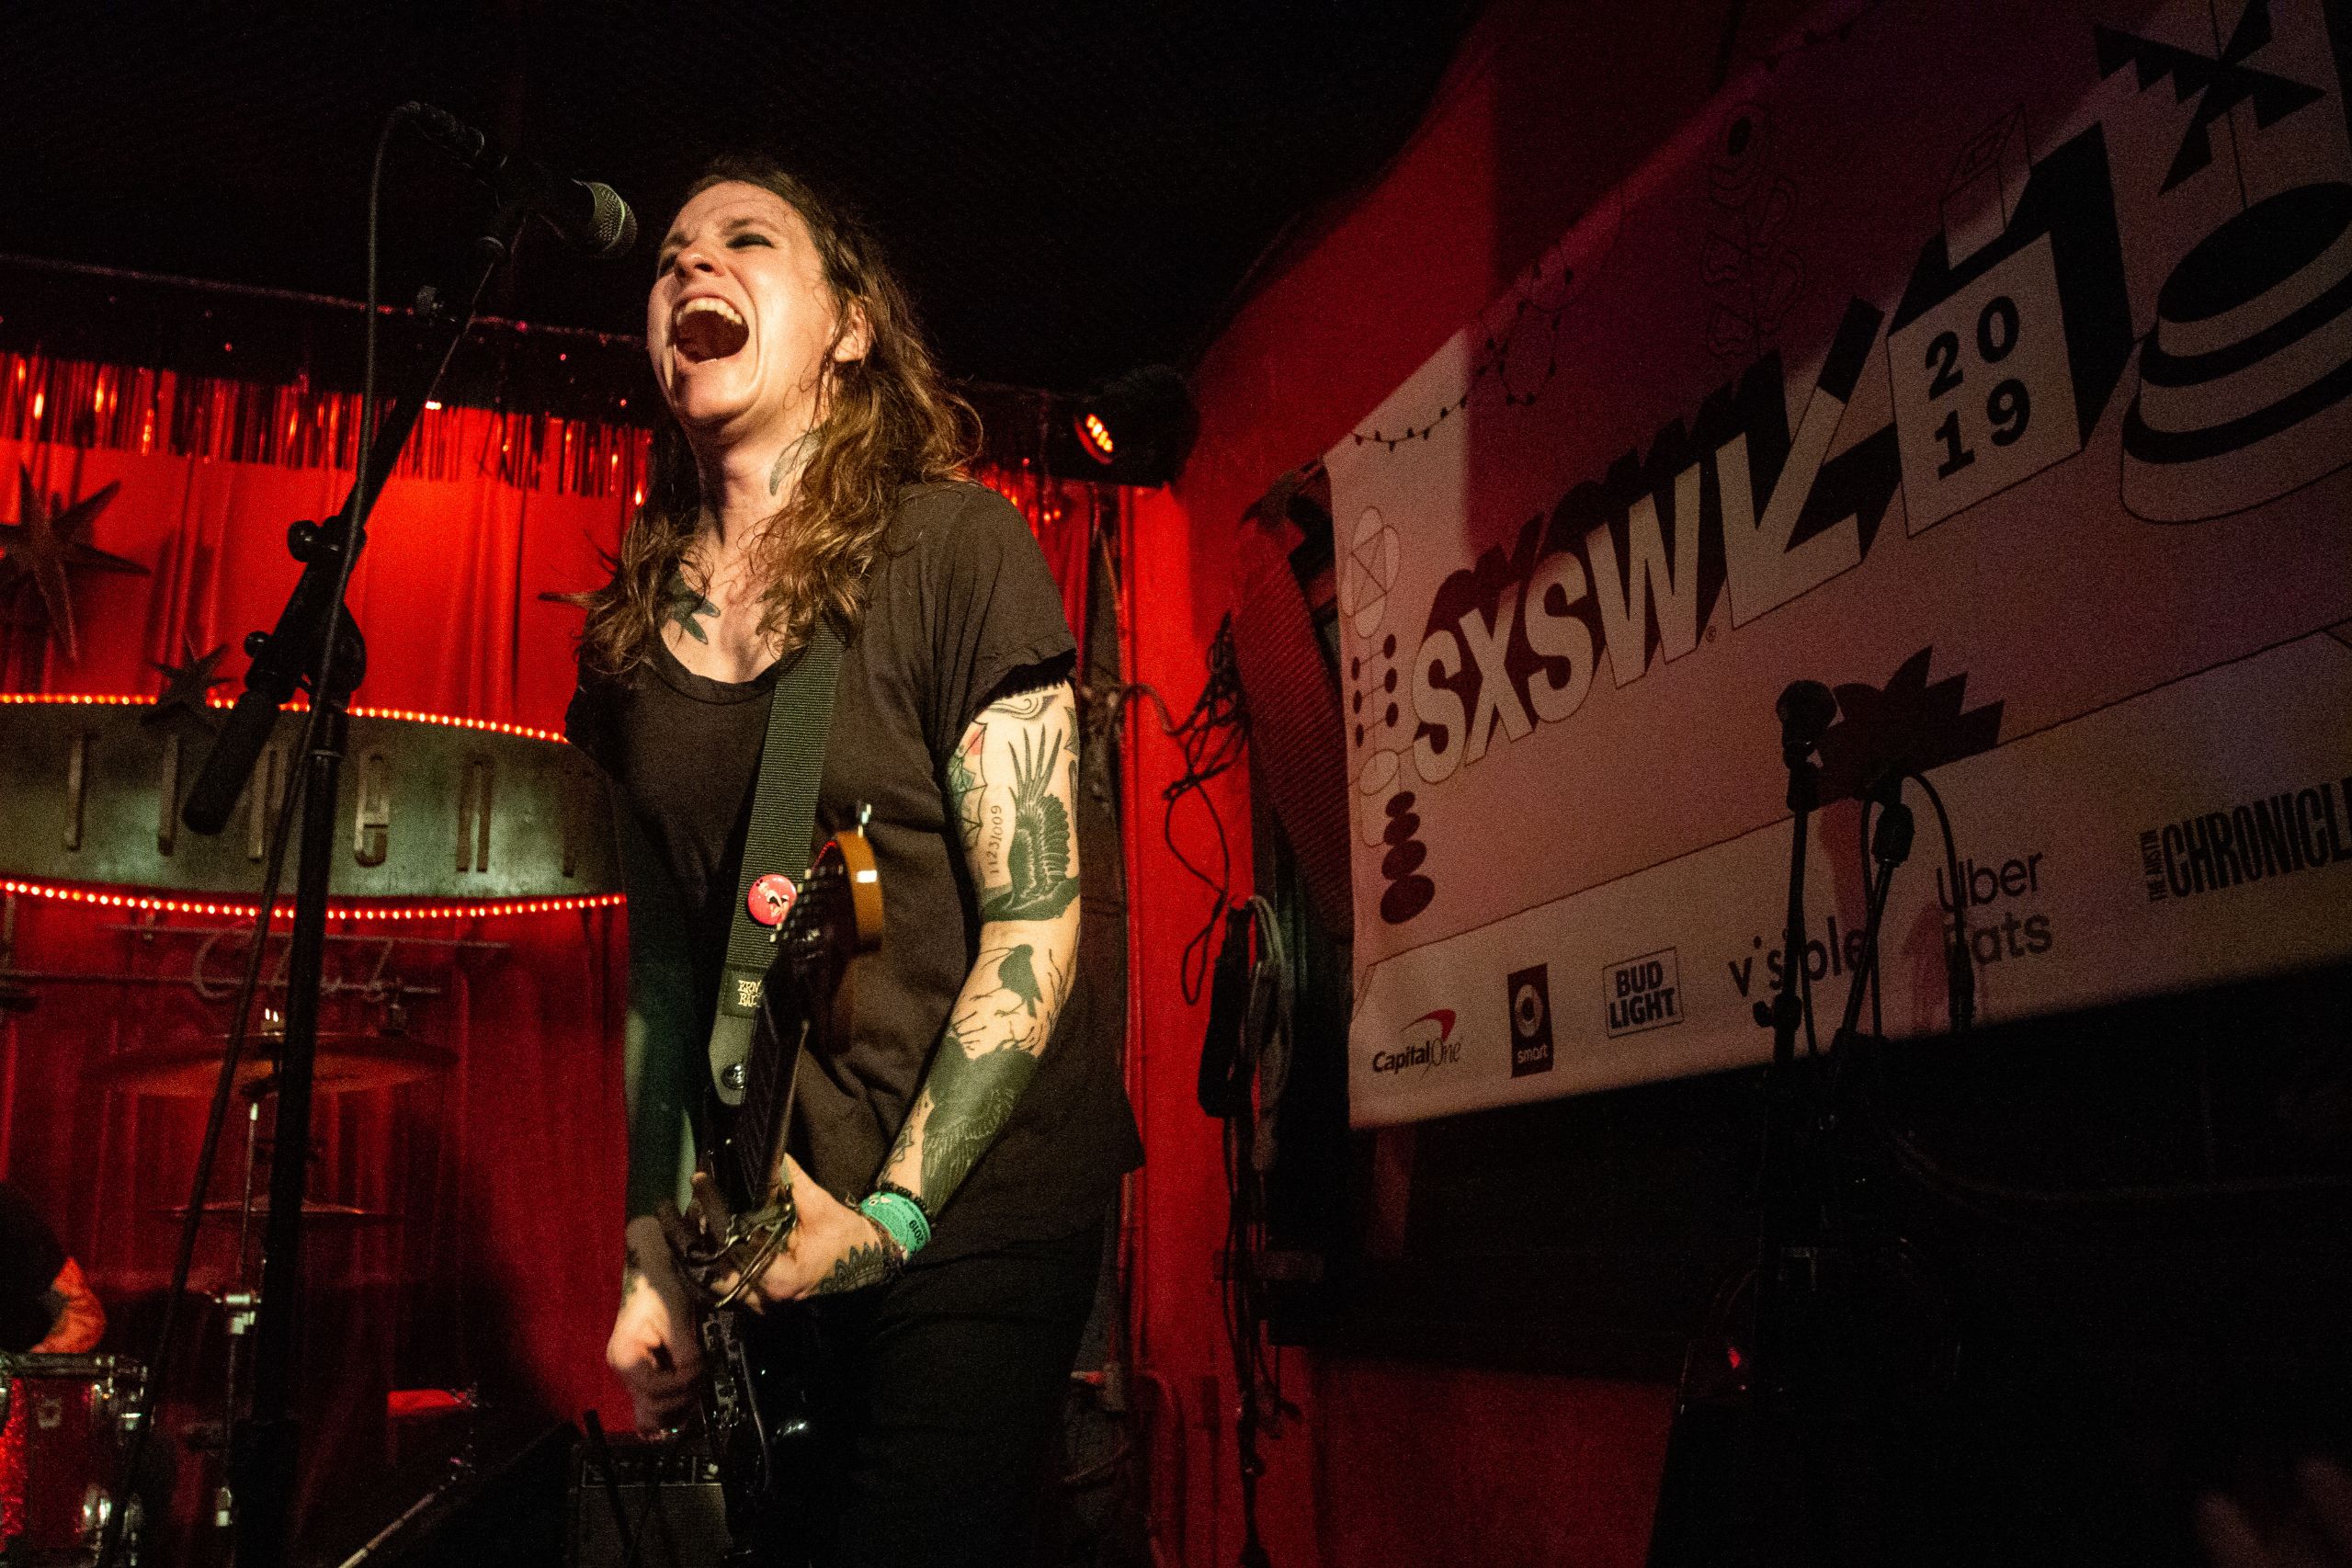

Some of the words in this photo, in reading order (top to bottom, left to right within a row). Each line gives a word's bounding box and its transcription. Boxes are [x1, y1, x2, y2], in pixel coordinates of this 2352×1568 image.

[1926, 297, 2020, 400] 20
[1936, 380, 2030, 481] 19
[1412, 462, 1701, 785] SXSW
[1937, 852, 2043, 913] Uber
[1943, 911, 2053, 965] ats
[1615, 960, 1664, 997] BUD
[1609, 987, 1675, 1029] LIGHT
[1517, 1043, 1548, 1064] smart
